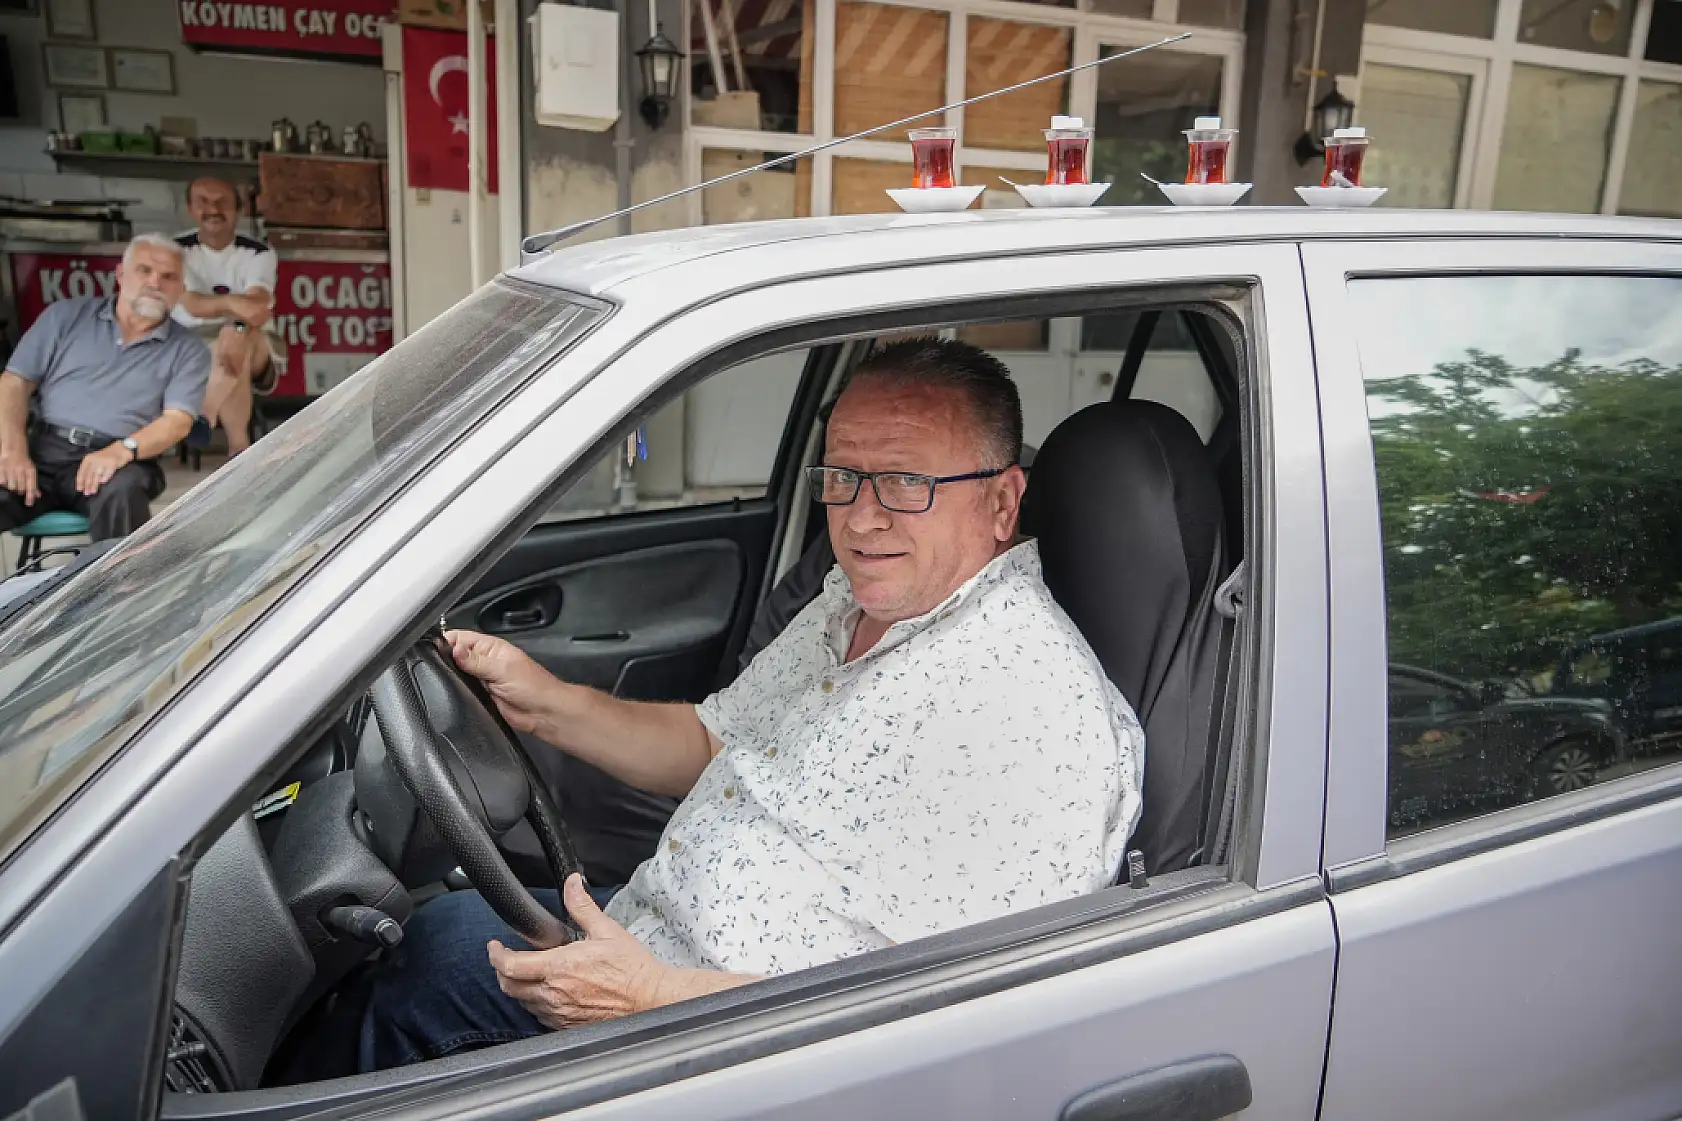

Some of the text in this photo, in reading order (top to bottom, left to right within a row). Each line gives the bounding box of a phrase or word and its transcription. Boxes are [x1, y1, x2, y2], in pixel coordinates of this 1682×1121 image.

[181, 0, 287, 32] KÖYMEN
[294, 8, 338, 38] ÇAY
[291, 265, 391, 310] OCAĞI
